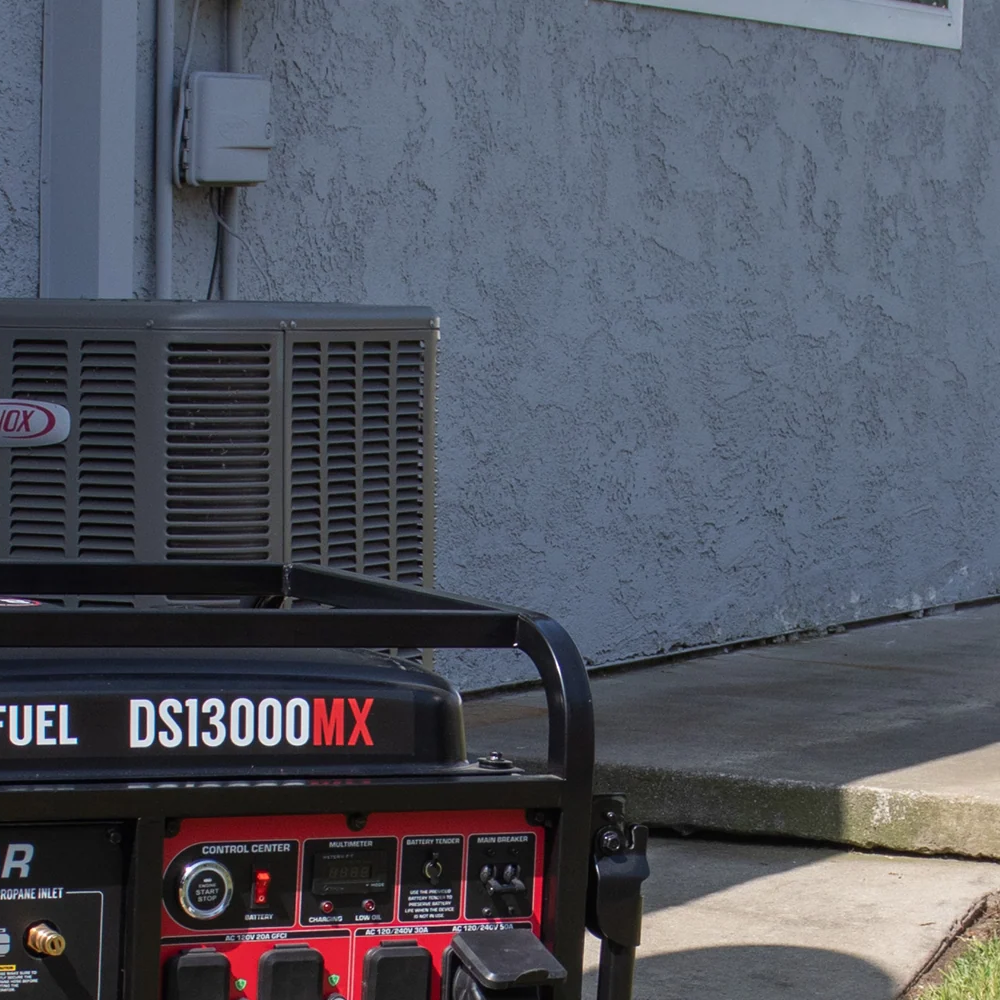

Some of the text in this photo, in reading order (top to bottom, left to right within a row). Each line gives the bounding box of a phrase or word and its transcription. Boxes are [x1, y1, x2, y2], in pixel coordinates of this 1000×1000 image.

[129, 697, 375, 749] DS13000MX
[202, 843, 290, 855] CONTROL CENTER
[329, 840, 373, 848] MULTIMETER
[38, 887, 64, 899] INLET
[308, 915, 343, 923] CHARGING
